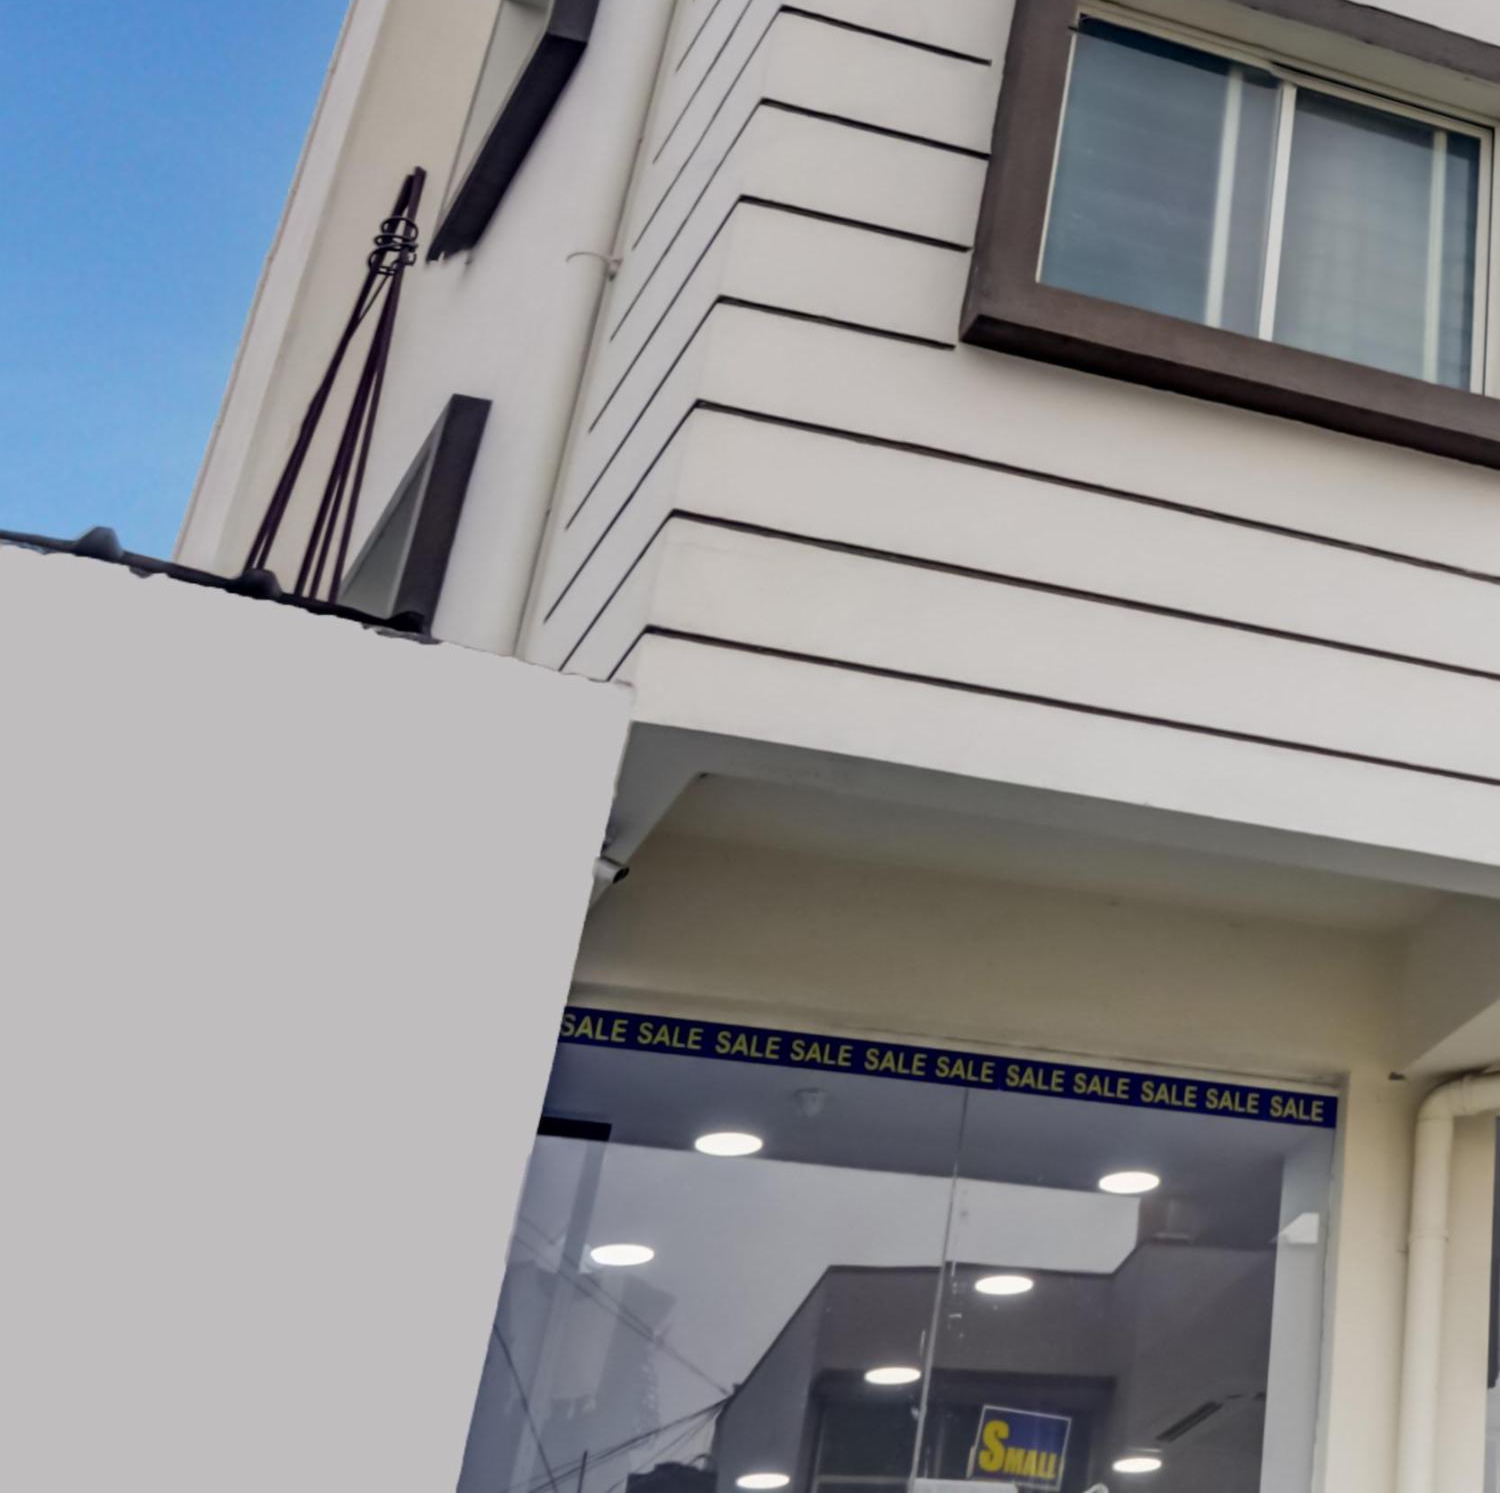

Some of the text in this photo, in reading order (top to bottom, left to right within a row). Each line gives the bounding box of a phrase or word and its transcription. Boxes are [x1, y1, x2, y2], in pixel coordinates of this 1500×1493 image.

[560, 1014, 1325, 1123] SALE SALE SALE SALE SALE SALE SALE SALE SALE SALE SALE
